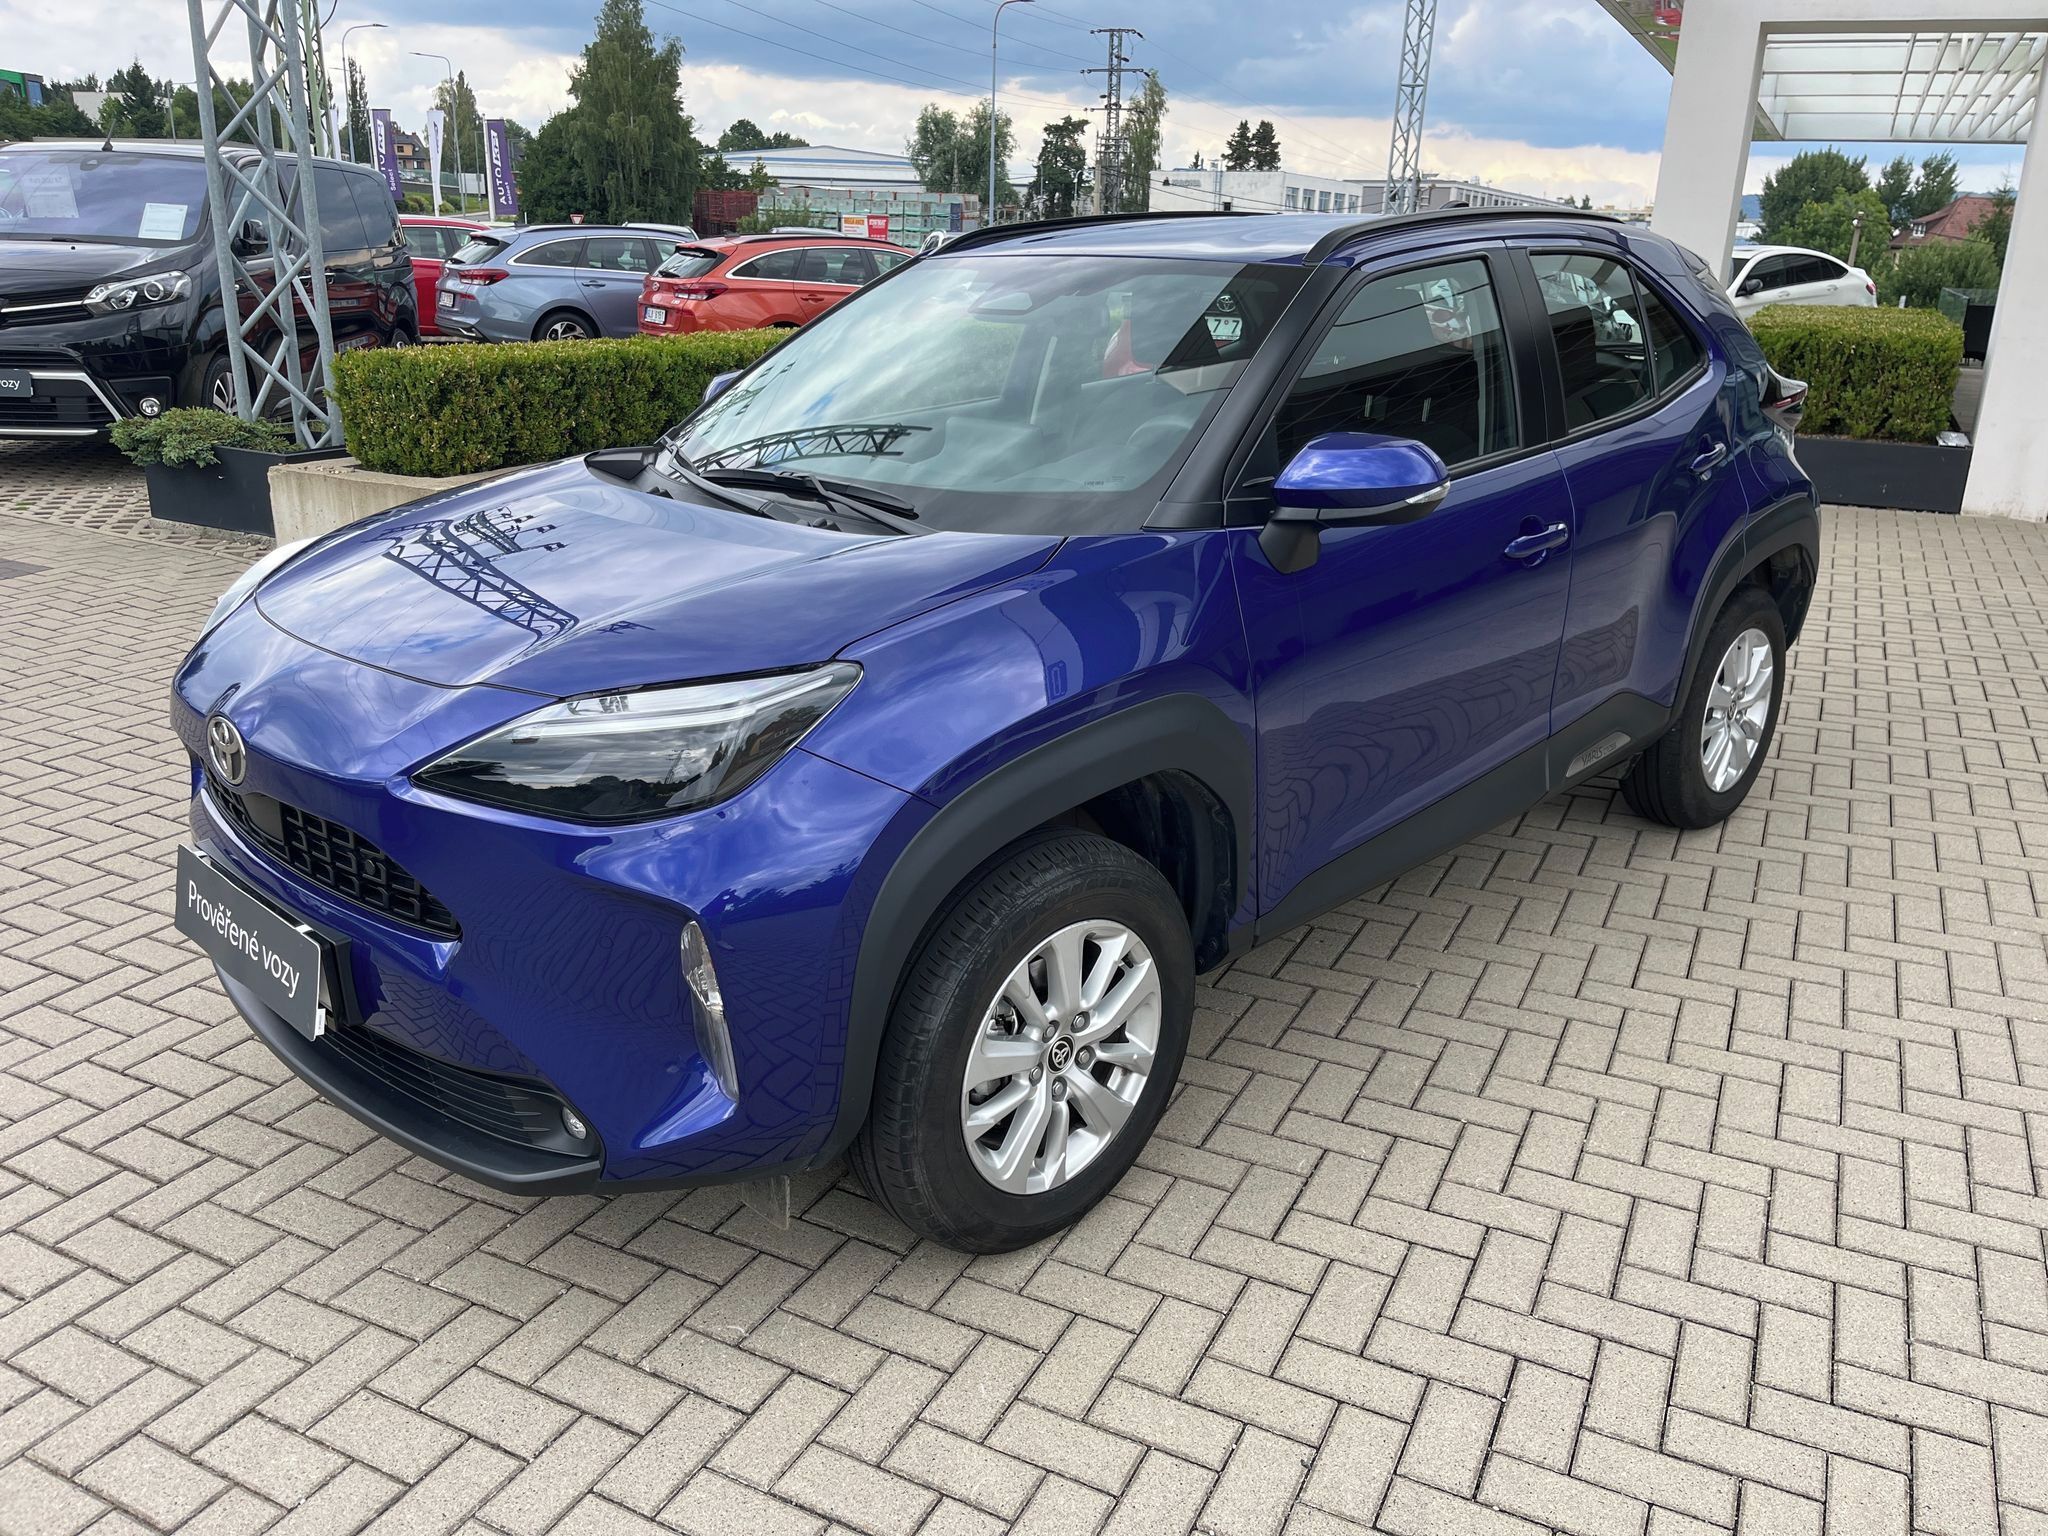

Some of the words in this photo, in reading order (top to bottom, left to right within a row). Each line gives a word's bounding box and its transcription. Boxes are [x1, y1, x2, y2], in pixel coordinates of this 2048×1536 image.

[495, 167, 507, 205] AUTO
[0, 380, 20, 390] ozy
[1582, 747, 1602, 768] YARIS
[188, 879, 259, 961] Prověřené
[262, 945, 300, 999] vozy
